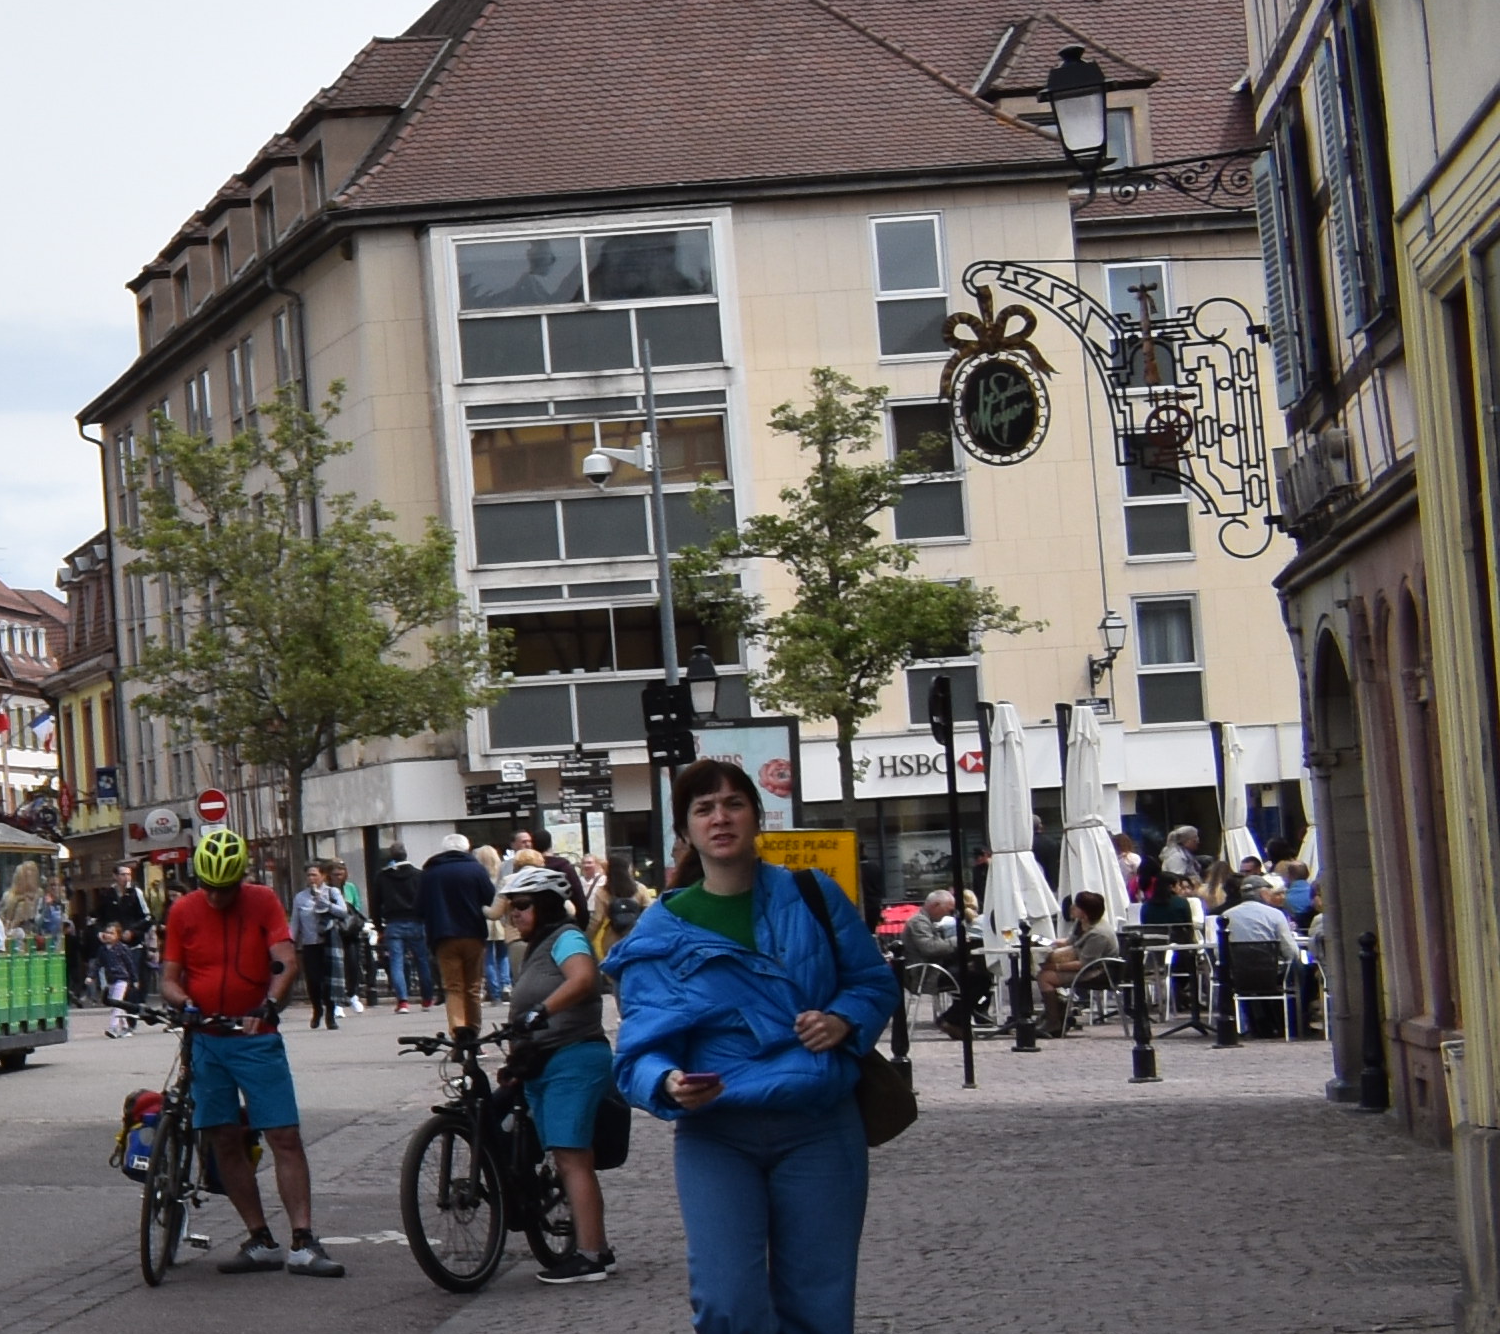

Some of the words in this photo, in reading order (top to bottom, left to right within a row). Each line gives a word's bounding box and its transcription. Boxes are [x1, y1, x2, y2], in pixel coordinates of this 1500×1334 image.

[878, 753, 947, 778] HSBC
[803, 838, 838, 850] PLACE
[785, 854, 799, 865] DE
[803, 854, 817, 865] LA
